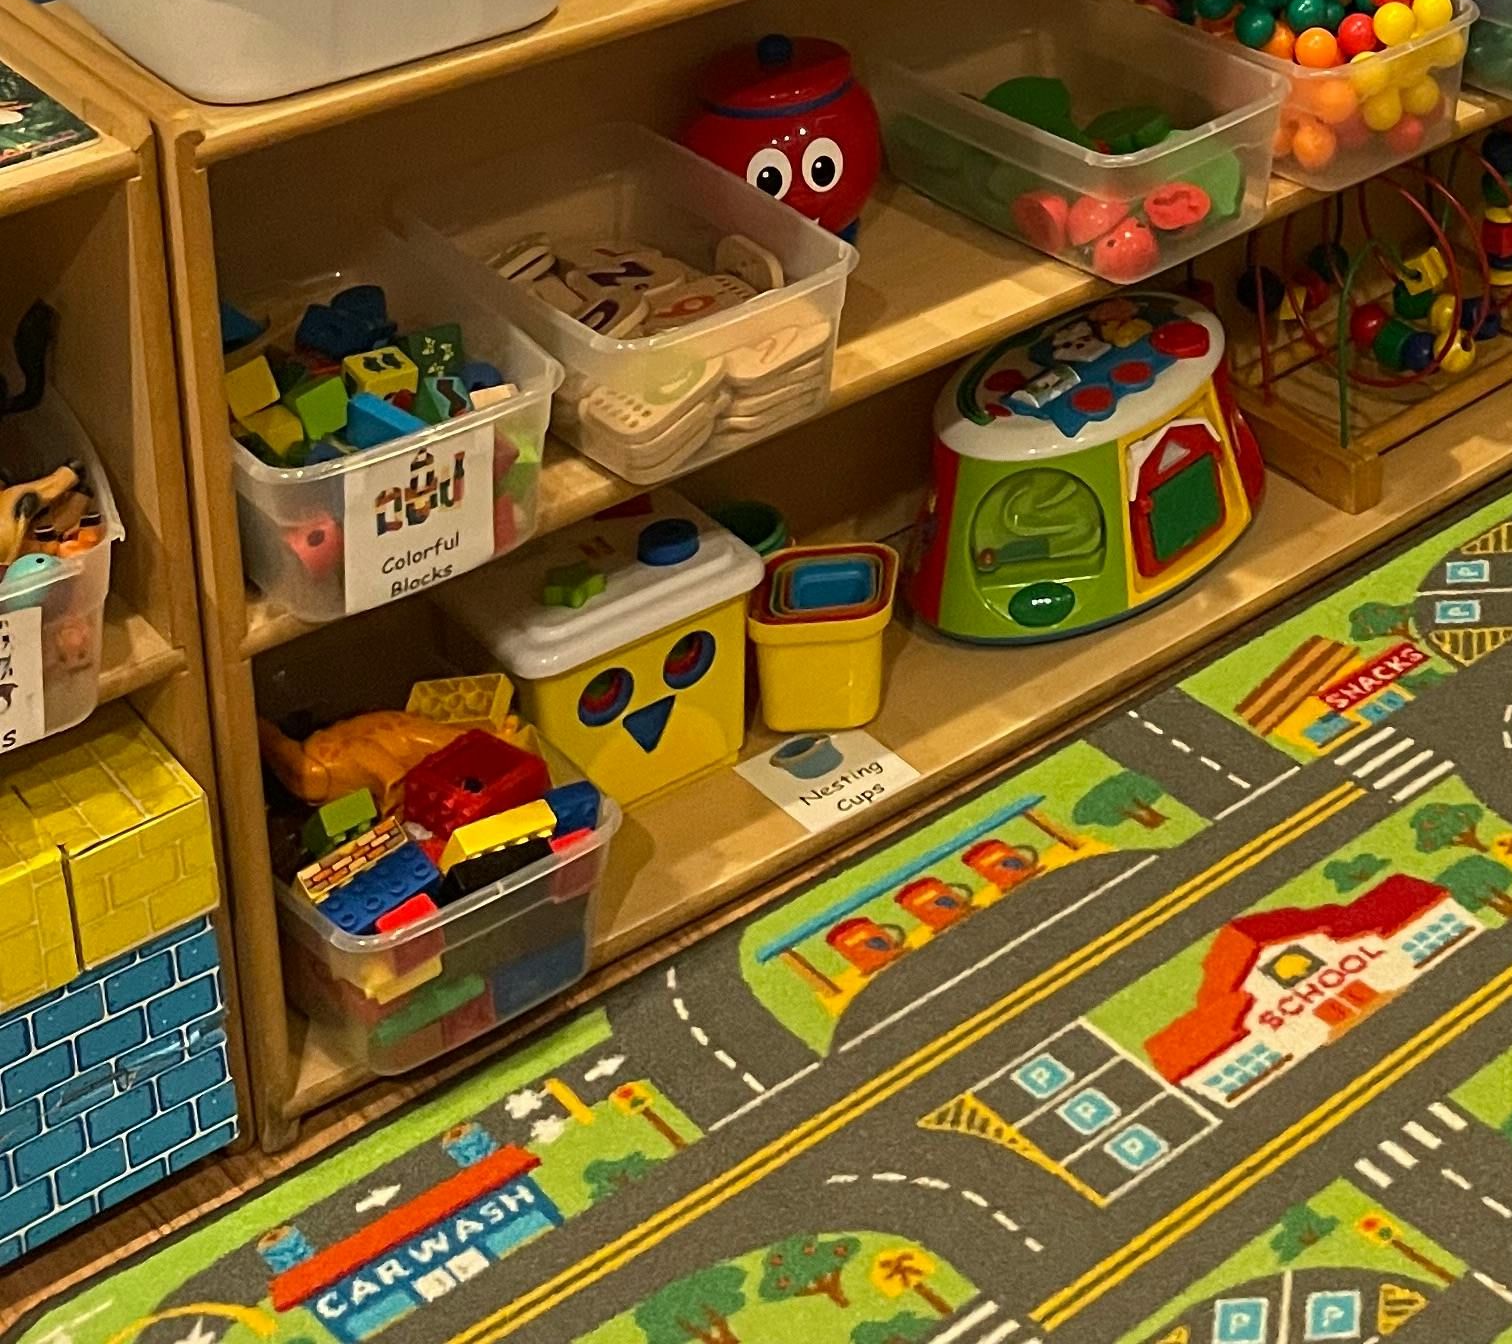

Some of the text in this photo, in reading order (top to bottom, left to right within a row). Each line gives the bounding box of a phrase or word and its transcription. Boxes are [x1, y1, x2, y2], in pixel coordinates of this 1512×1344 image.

[381, 530, 459, 575] Colorful
[390, 564, 453, 598] Blocks
[1325, 648, 1424, 709] SNACKS
[799, 760, 884, 806] Nesting
[836, 782, 885, 812] Cups
[1256, 944, 1388, 1032] SCHOOL
[315, 1183, 537, 1320] CAR WASH
[1229, 1311, 1251, 1335] P
